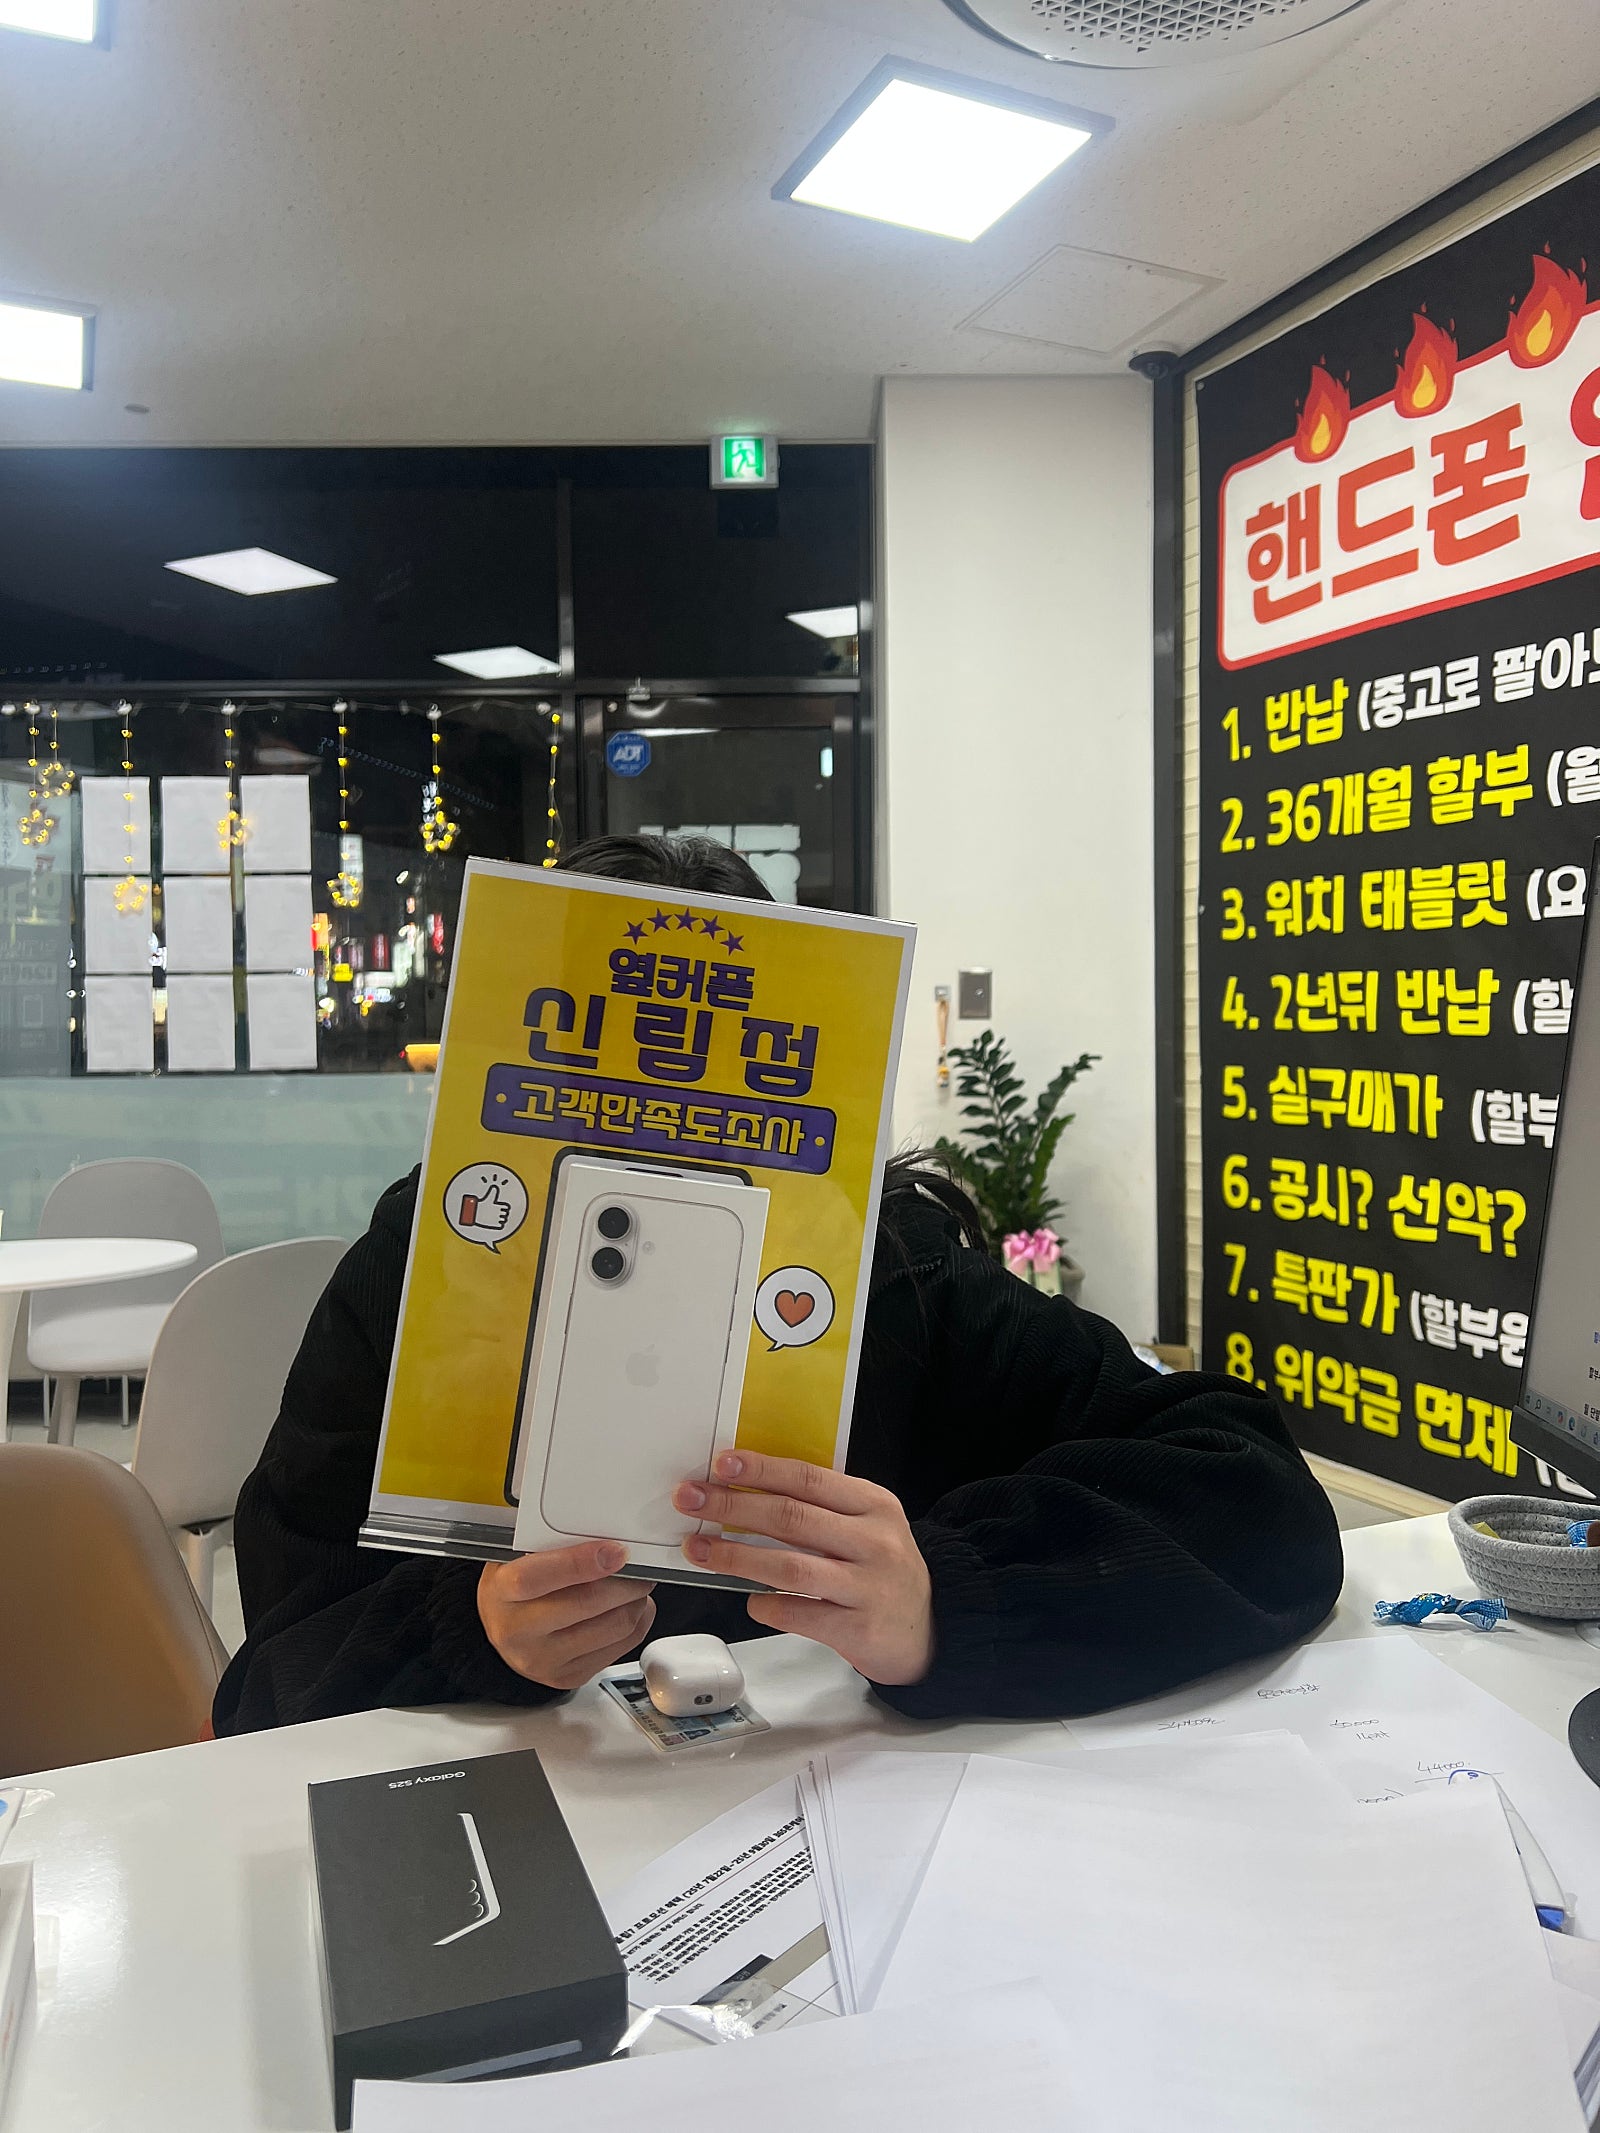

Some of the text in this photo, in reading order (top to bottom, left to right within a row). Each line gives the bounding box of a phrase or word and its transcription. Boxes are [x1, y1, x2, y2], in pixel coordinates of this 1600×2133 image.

[1246, 402, 1530, 625] 핸드폰
[1221, 626, 1600, 762] 1. 반납 (중고로 팔아
[612, 744, 645, 763] ADT
[1220, 797, 1256, 853] 2.
[1266, 764, 1412, 846] 36개월
[1426, 743, 1533, 825] 할부
[1220, 859, 1587, 941] 3. 워치 태블릿 (요
[609, 948, 756, 1012] 옆커폰
[1221, 967, 1575, 1037] 4. 2년뒤 반납 (할
[513, 1081, 806, 1156] 고객만족도조사
[1222, 1064, 1560, 1149] 5. 실구매가 (할부
[1222, 1153, 1527, 1258] 6. 공시? 선약?
[1223, 1242, 1260, 1303] 7.
[1272, 1249, 1400, 1335] 특판가
[1225, 1331, 1519, 1477] 8. 위약금 면제
[388, 1771, 466, 1789] Galaxy S25
